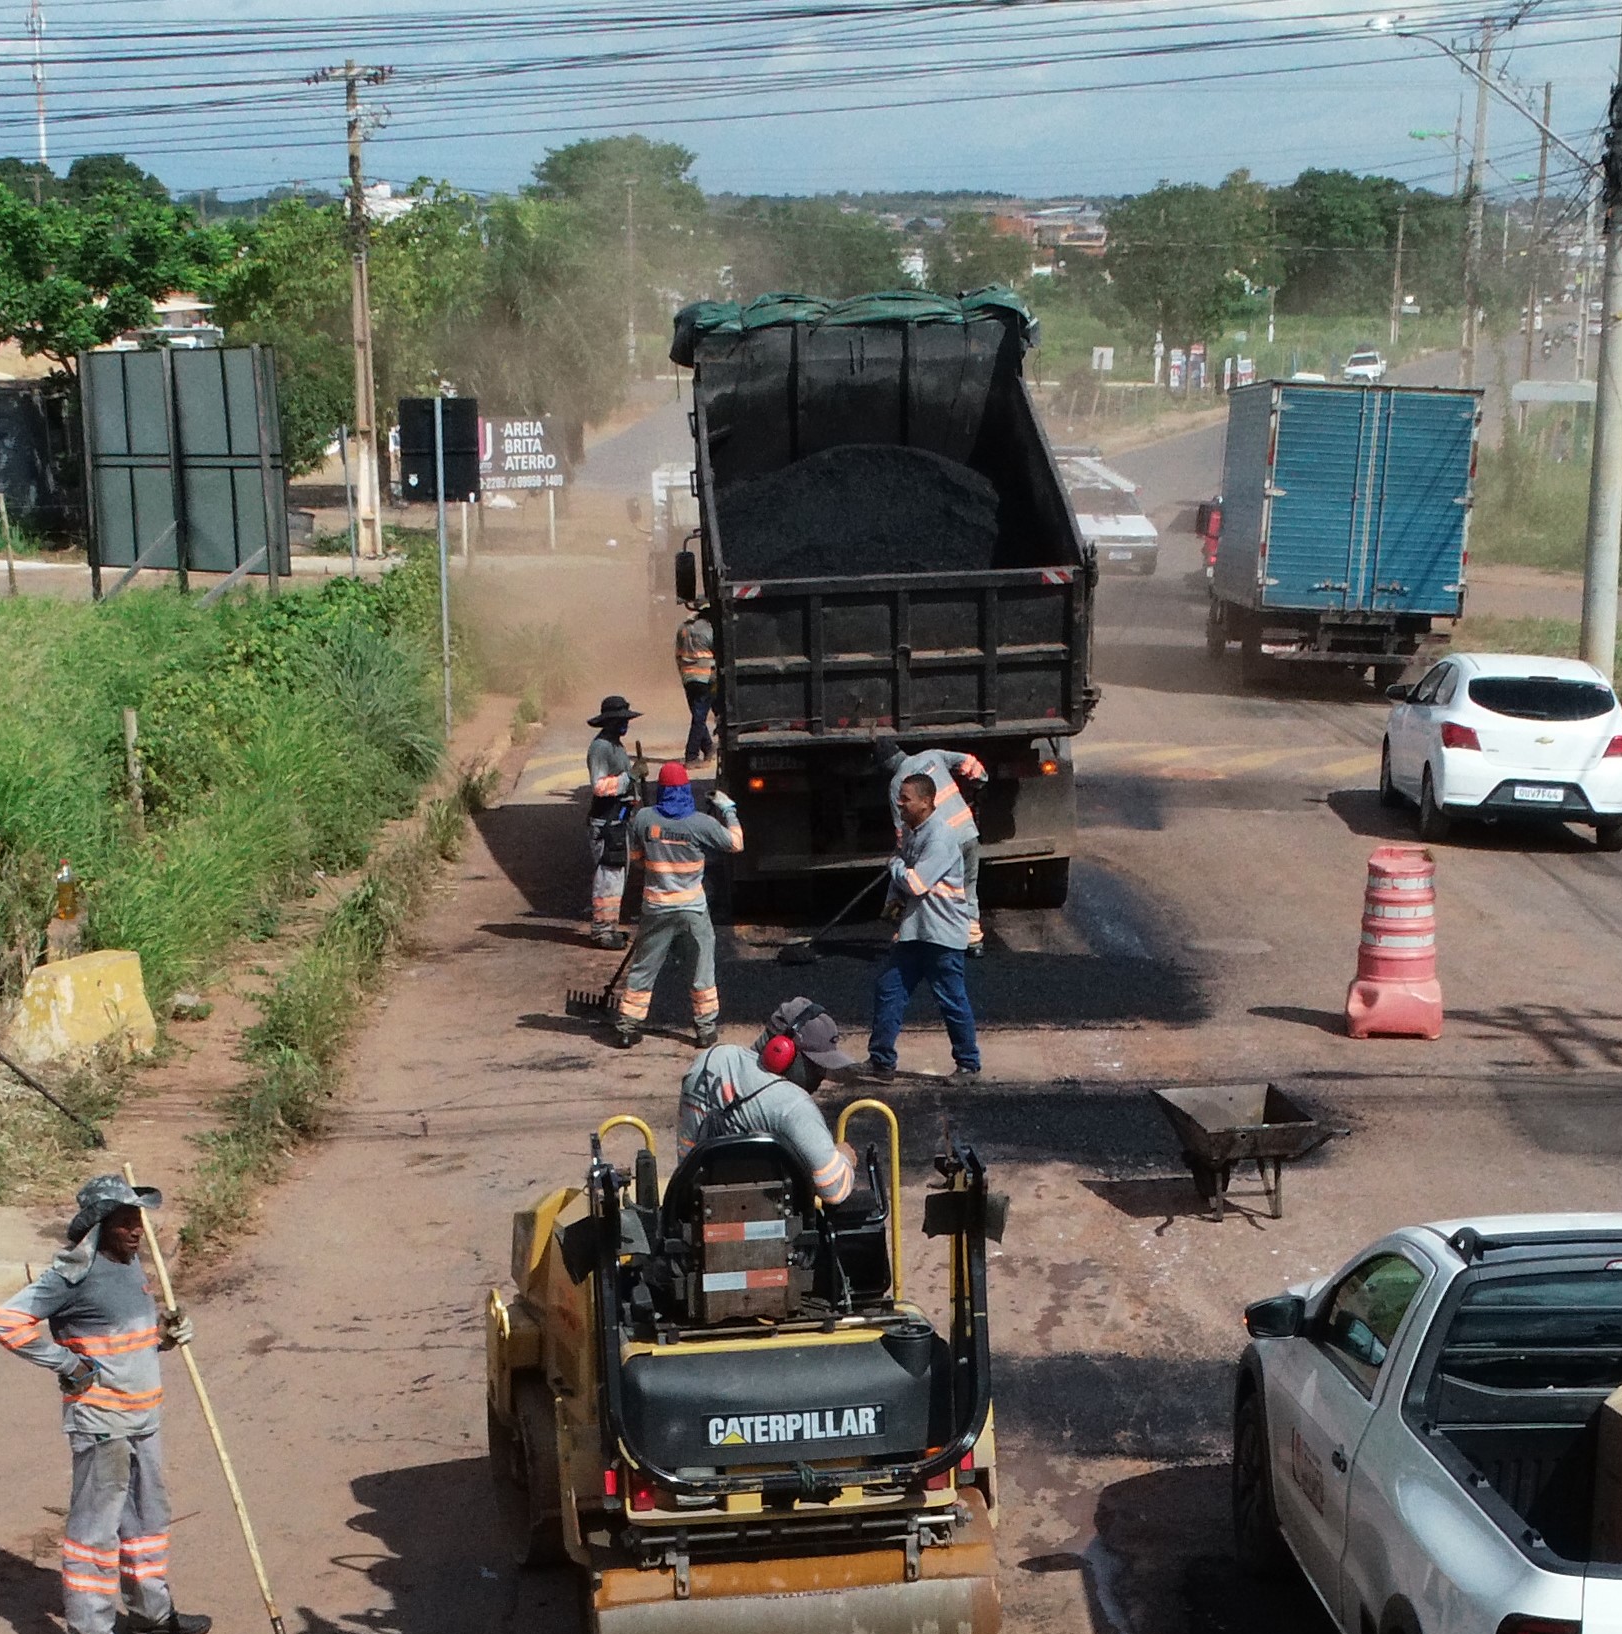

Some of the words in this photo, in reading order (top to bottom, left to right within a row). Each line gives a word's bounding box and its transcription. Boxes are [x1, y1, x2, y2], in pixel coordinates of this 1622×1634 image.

[504, 421, 544, 437] AREIA
[504, 438, 543, 454] BRITA
[504, 454, 557, 471] ATERRO
[708, 1406, 877, 1446] CATERPILLAR
